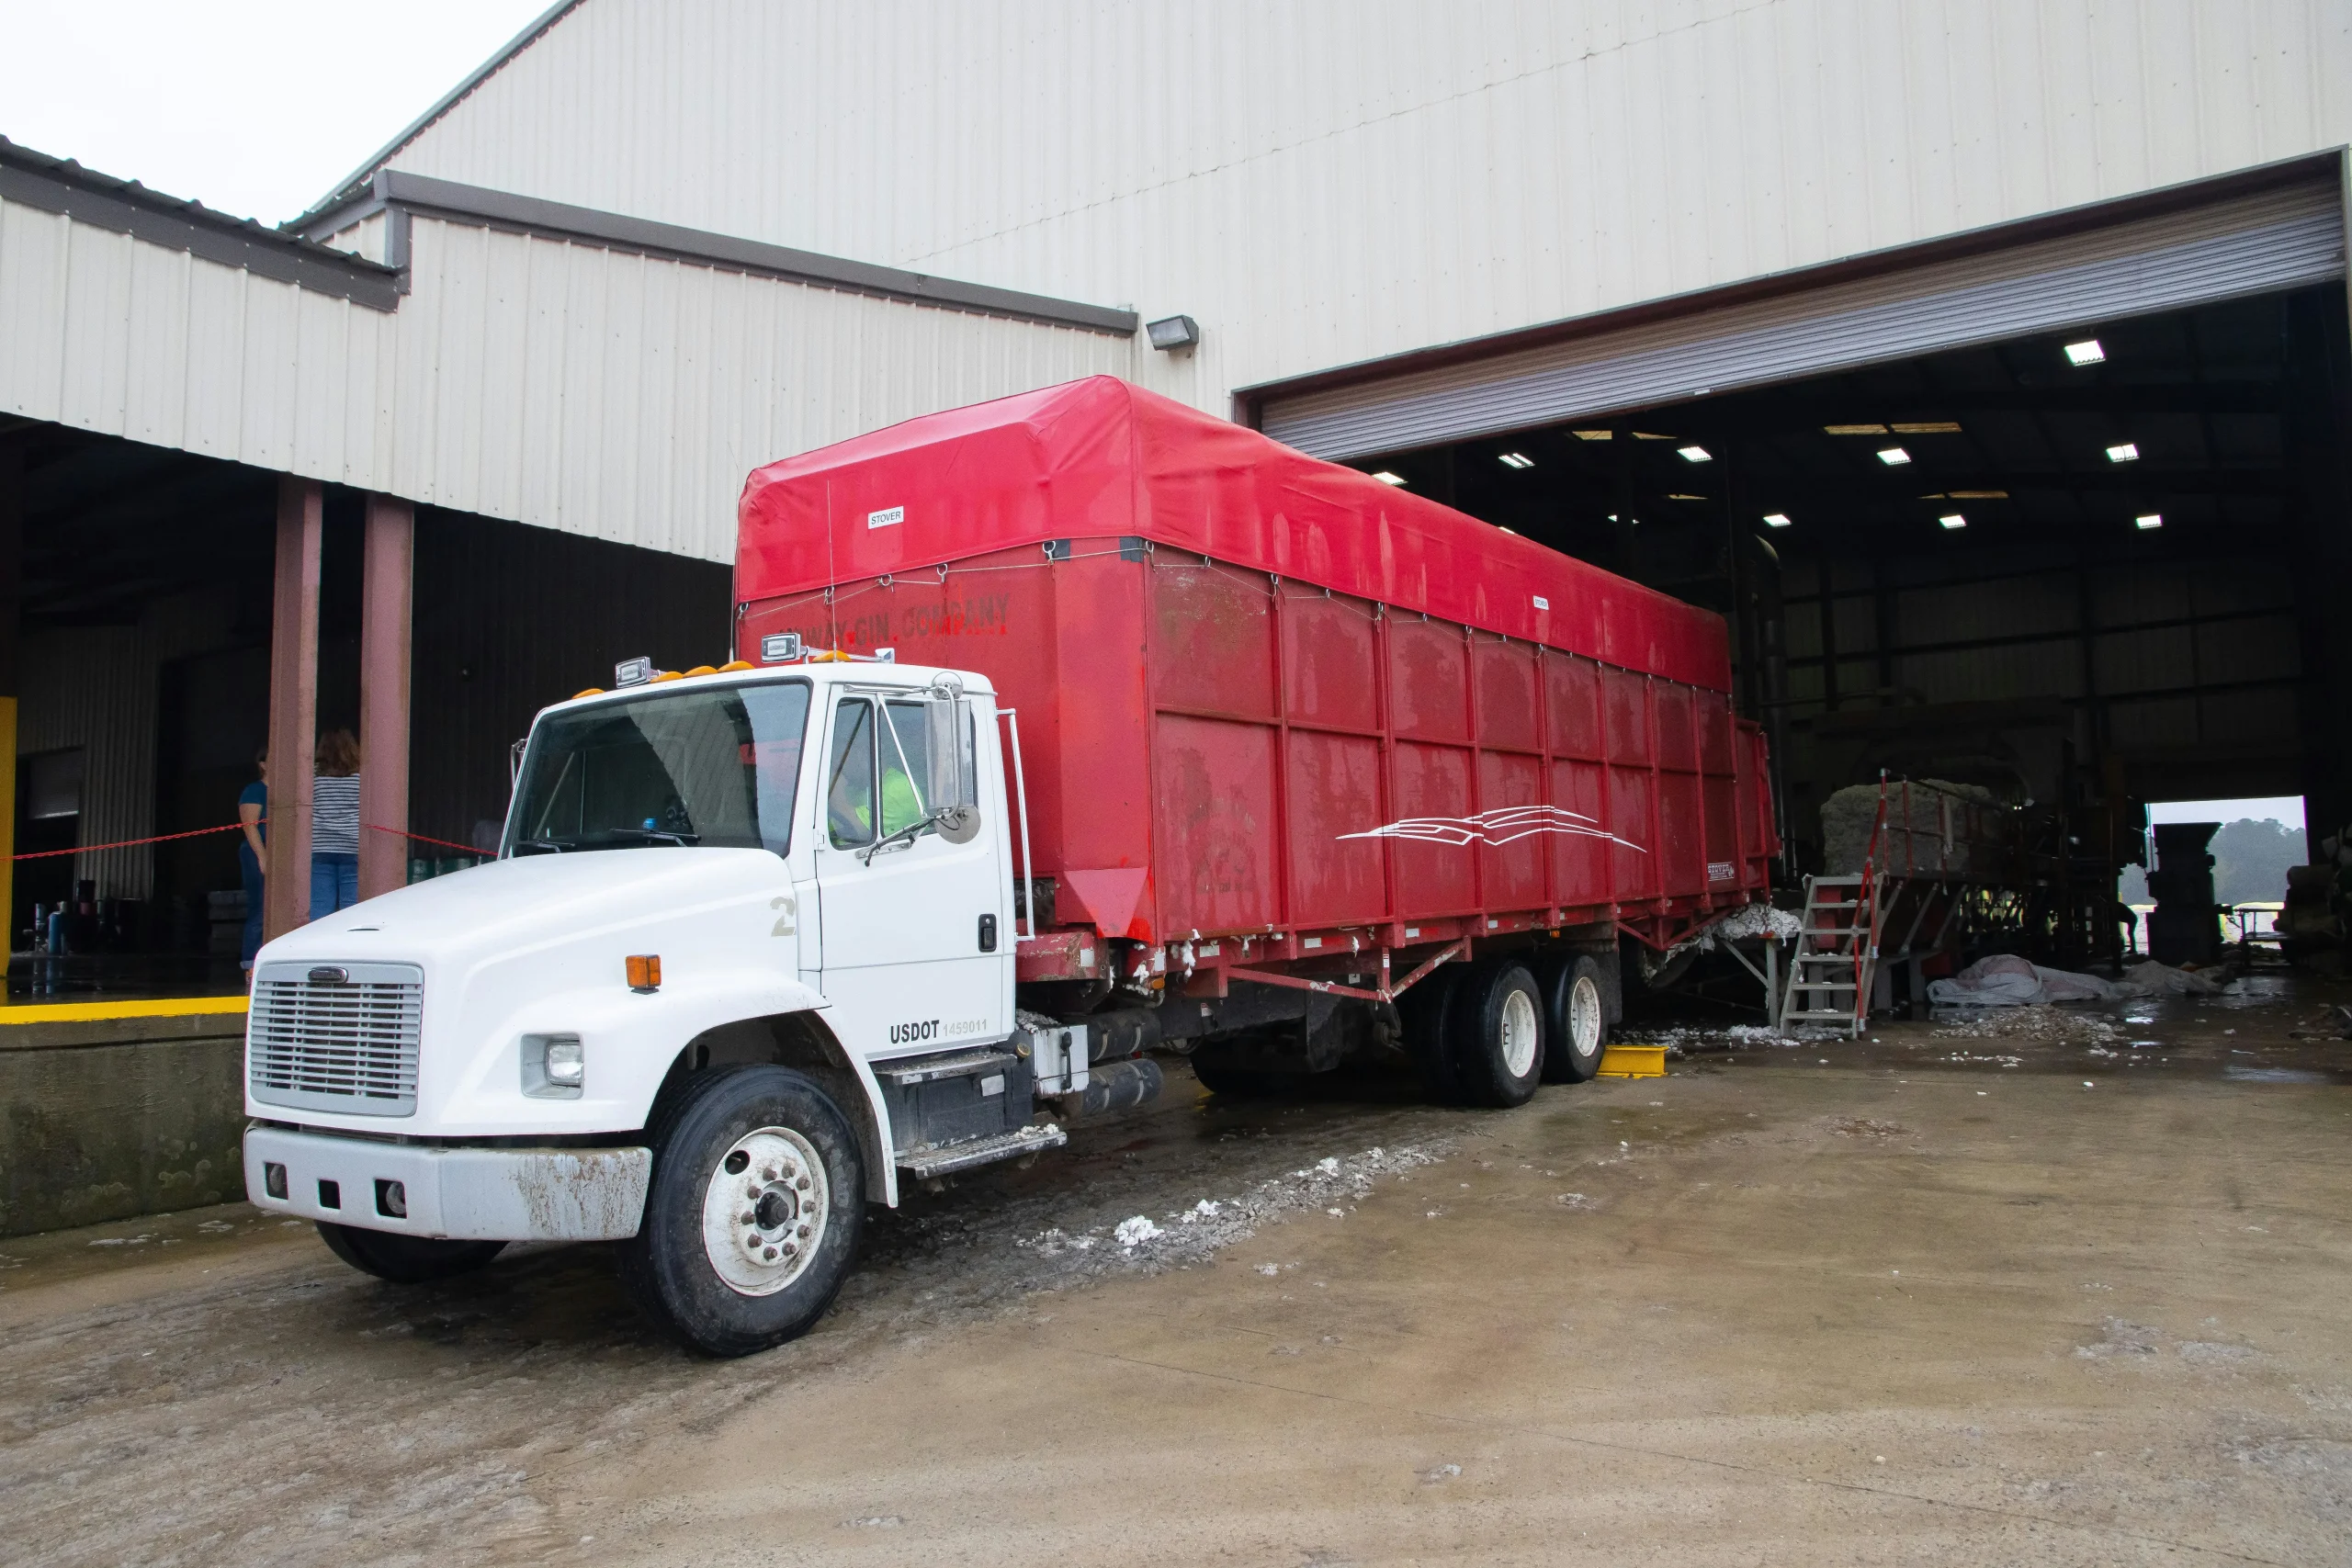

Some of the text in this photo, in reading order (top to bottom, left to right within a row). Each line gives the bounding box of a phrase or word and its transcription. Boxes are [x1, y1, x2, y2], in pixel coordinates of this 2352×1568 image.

[871, 511, 901, 525] STOVER
[854, 612, 889, 646] GIN
[901, 592, 1010, 637] COMPANY
[769, 896, 797, 937] 2
[890, 1018, 988, 1044] USDOT 1459011
